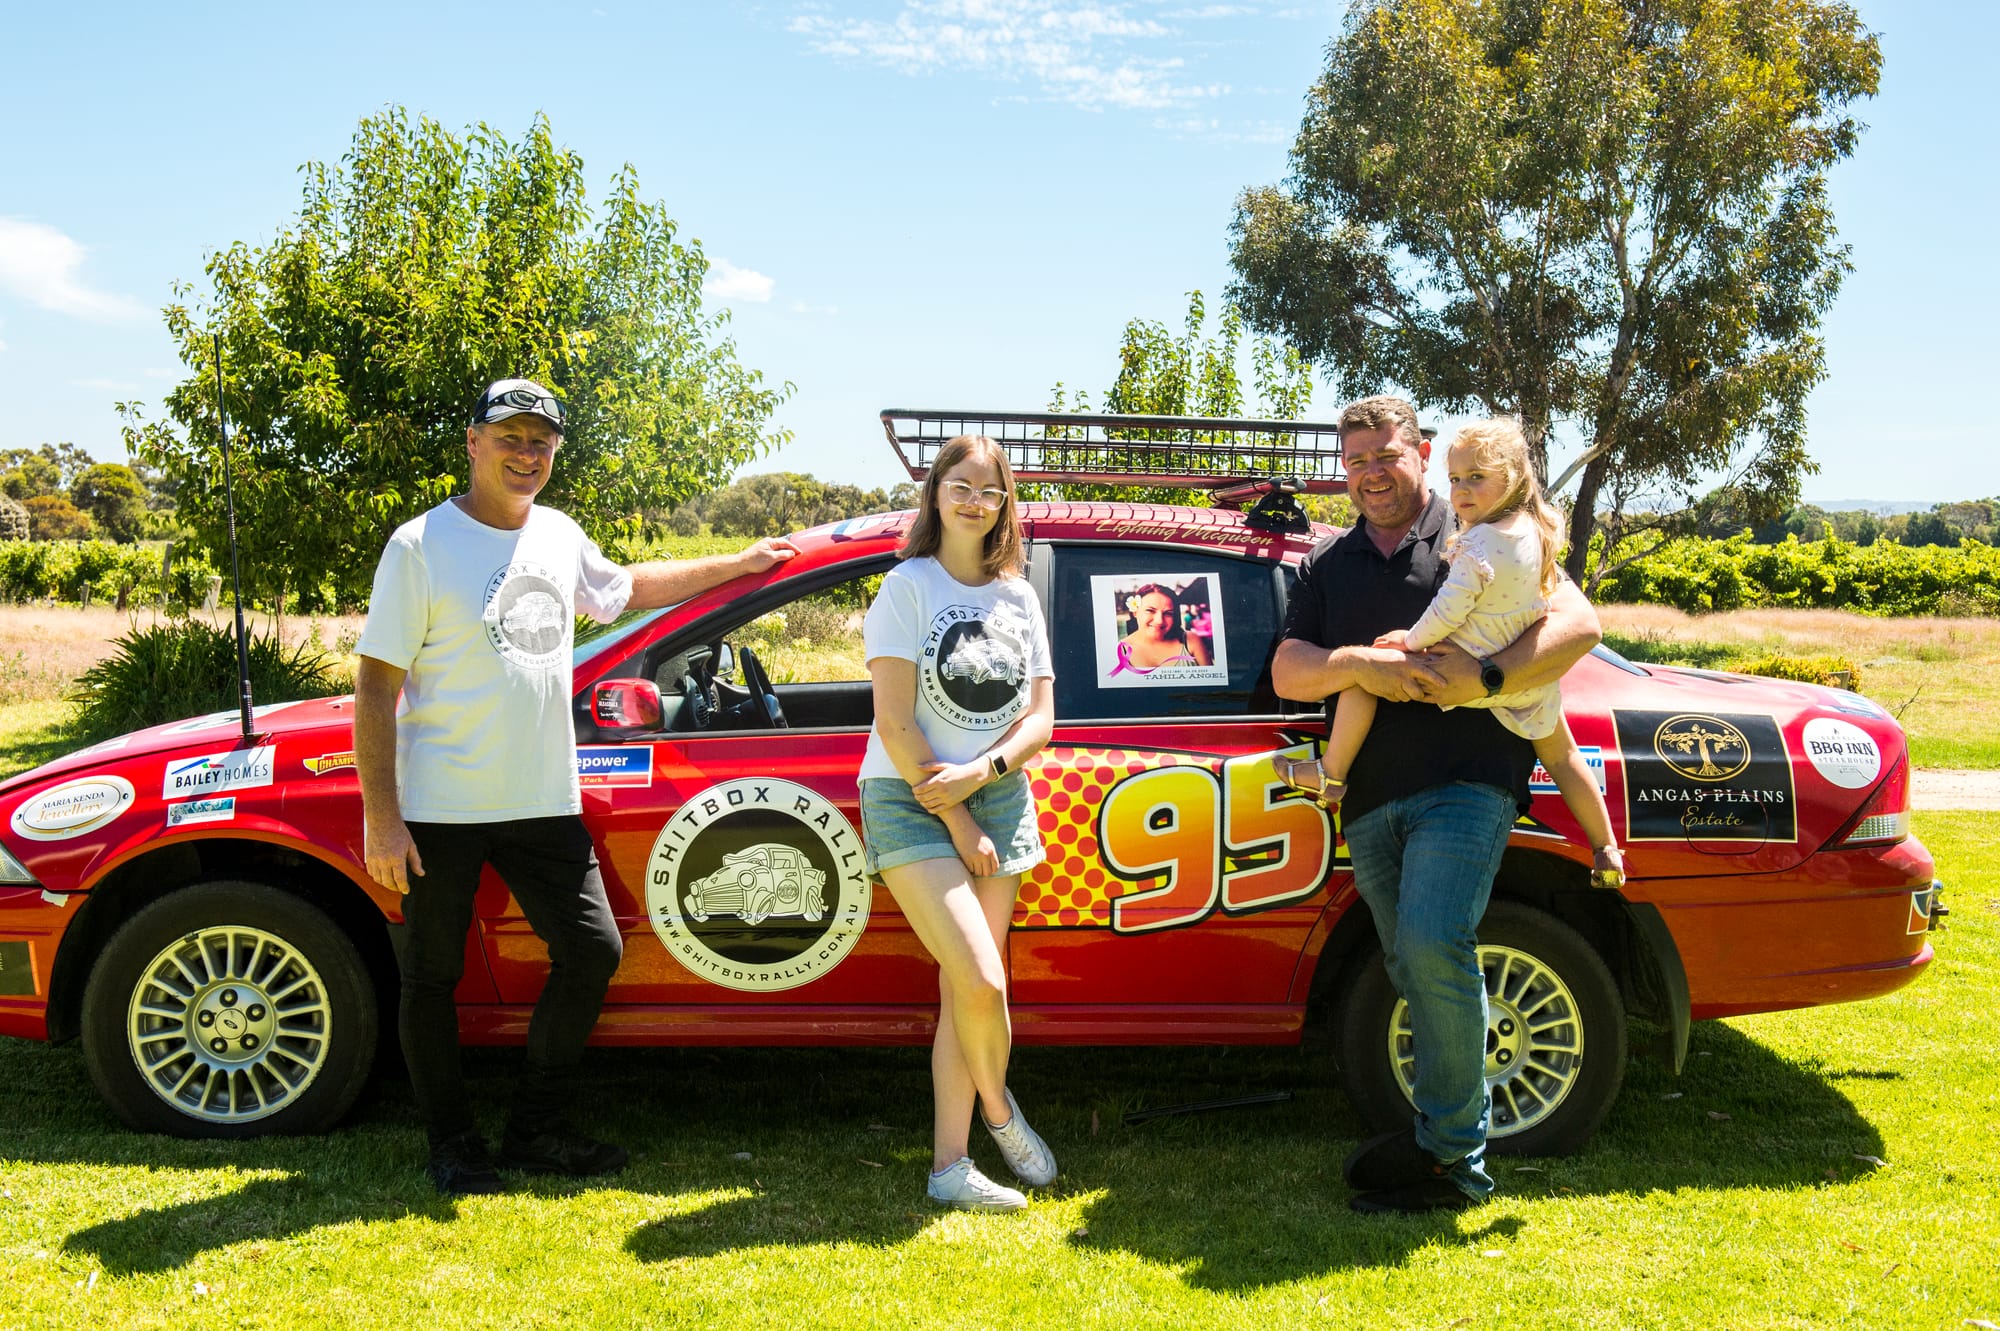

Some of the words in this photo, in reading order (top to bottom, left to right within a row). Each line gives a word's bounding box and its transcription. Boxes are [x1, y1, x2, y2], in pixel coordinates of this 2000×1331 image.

[924, 610, 980, 657] SHITBOX
[1809, 741, 1844, 755] BBQ
[1846, 742, 1875, 756] INN
[175, 770, 221, 788] BAILEY
[224, 763, 269, 781] HOMES
[576, 756, 629, 770] epower
[42, 799, 71, 809] MARIA
[73, 791, 105, 804] KENDA
[1637, 788, 1704, 802] ANGAS
[1714, 788, 1785, 803] PLAINS
[36, 802, 104, 823] Jewellery
[1680, 805, 1745, 832] Estate
[653, 786, 770, 886] SHITBOX
[793, 795, 864, 884] RALLY
[1099, 741, 1335, 935] 95
[659, 904, 859, 982] WWW.SHITBOXRALLY.COM.AU
